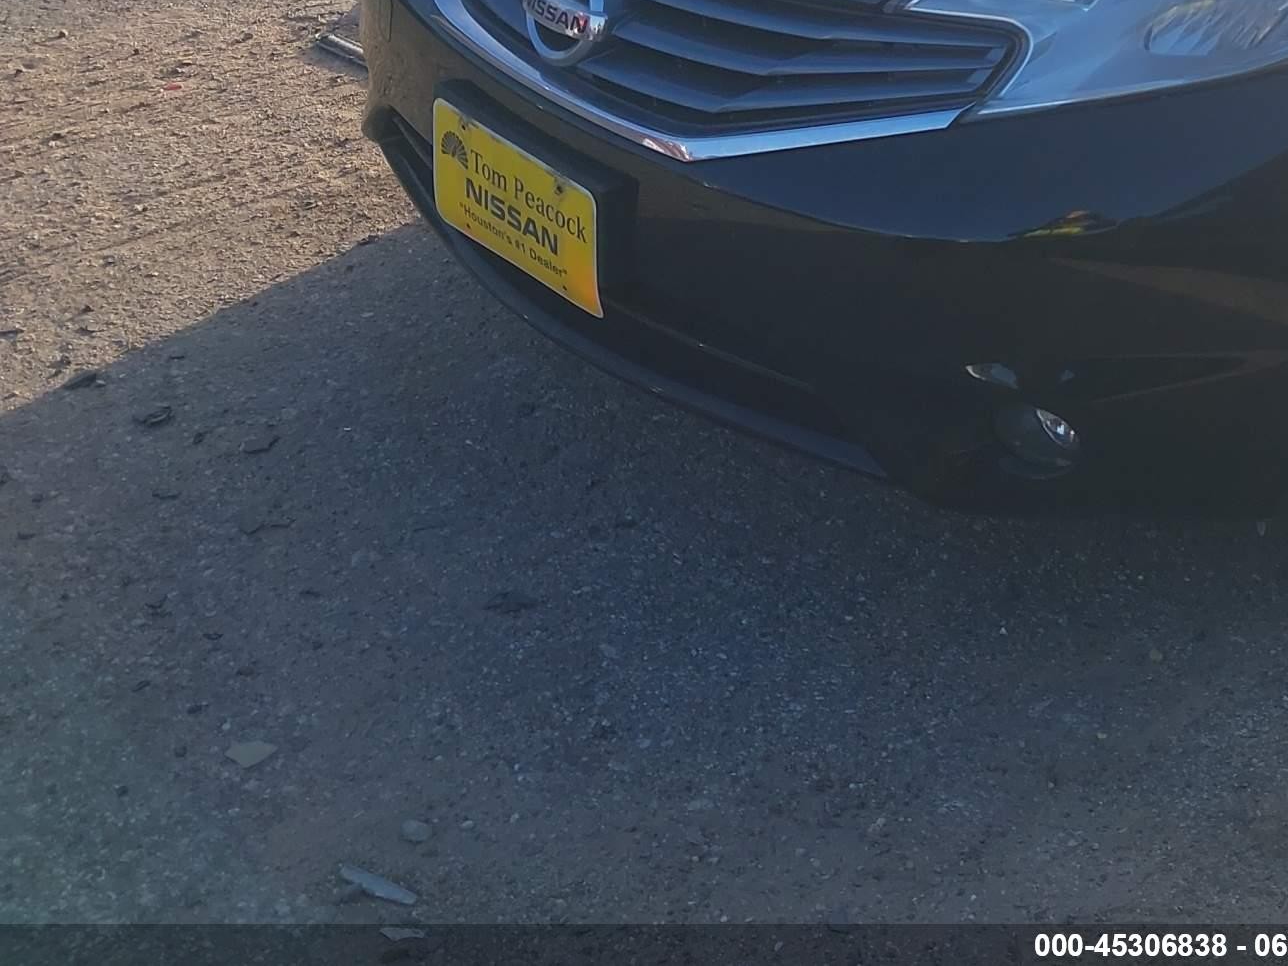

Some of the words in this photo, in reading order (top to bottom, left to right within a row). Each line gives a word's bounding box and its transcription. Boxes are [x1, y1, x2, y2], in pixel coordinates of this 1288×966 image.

[465, 177, 558, 256] NISSAN
[470, 148, 507, 192] Tom
[514, 176, 587, 243] Peacock
[515, 239, 526, 254] #1
